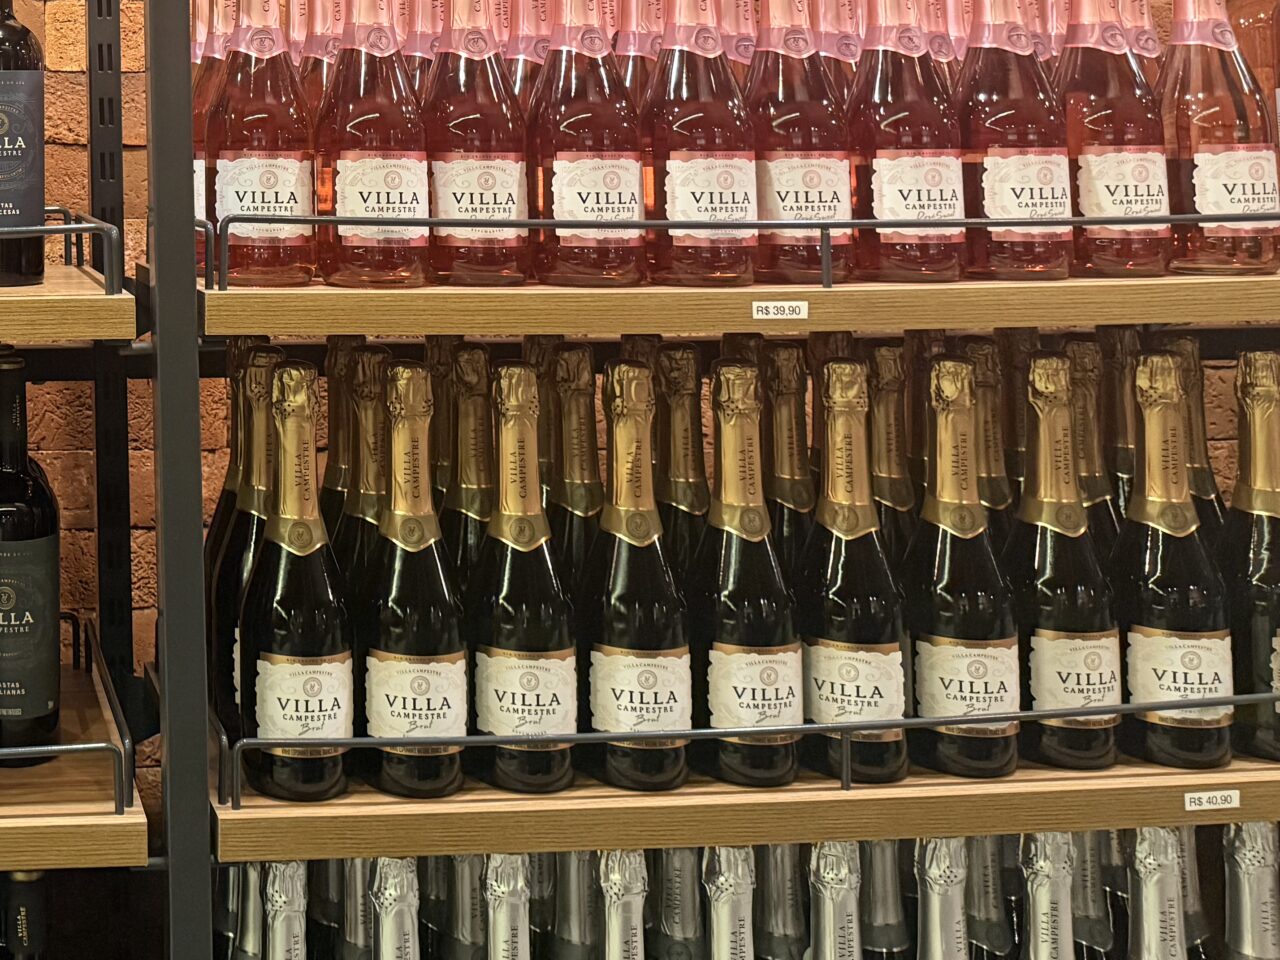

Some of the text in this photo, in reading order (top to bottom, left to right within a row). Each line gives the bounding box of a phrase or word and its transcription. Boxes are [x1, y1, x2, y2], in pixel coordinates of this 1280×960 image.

[898, 189, 958, 202] VILLA
[1011, 187, 1068, 200] VILLA
[1105, 184, 1164, 197] VILLA
[1222, 183, 1277, 196] VILLA
[235, 191, 298, 204] VILLA
[358, 191, 419, 205] VILLA
[452, 192, 516, 205] VILLA
[577, 192, 638, 204] VILLA
[690, 192, 751, 204] VILLA
[776, 191, 841, 204] VILLA
[782, 204, 837, 212] CAMPESTRE
[757, 306, 800, 316] R$ 39,90
[403, 451, 411, 484] VILLA
[510, 452, 518, 483] VILLA
[836, 447, 844, 478] VILLA
[844, 434, 853, 493] CAMPESTRE
[1057, 670, 1117, 685] VILLA
[1152, 668, 1222, 685] VILLA
[814, 677, 884, 699] VILLA
[939, 677, 1008, 694] VILLA
[1064, 685, 1114, 694] CAMPESTRE
[1159, 684, 1218, 693] CAMPESTRE
[494, 689, 561, 706] VILLA
[611, 688, 678, 704] VILLA
[732, 685, 796, 701] VILLA
[946, 693, 1004, 703] CAMPESTRE
[277, 697, 341, 713] VILLA
[385, 694, 451, 711] VILLA
[739, 701, 792, 710] CAMPESTRE
[819, 693, 879, 707] CAMPESTRE
[390, 710, 447, 720] CAMPESTRE
[500, 705, 556, 716] CAMPESTRE
[617, 705, 674, 714] CAMPESTRE
[282, 712, 338, 722] CAMPESTRE
[1189, 795, 1232, 806] R$ 40,90
